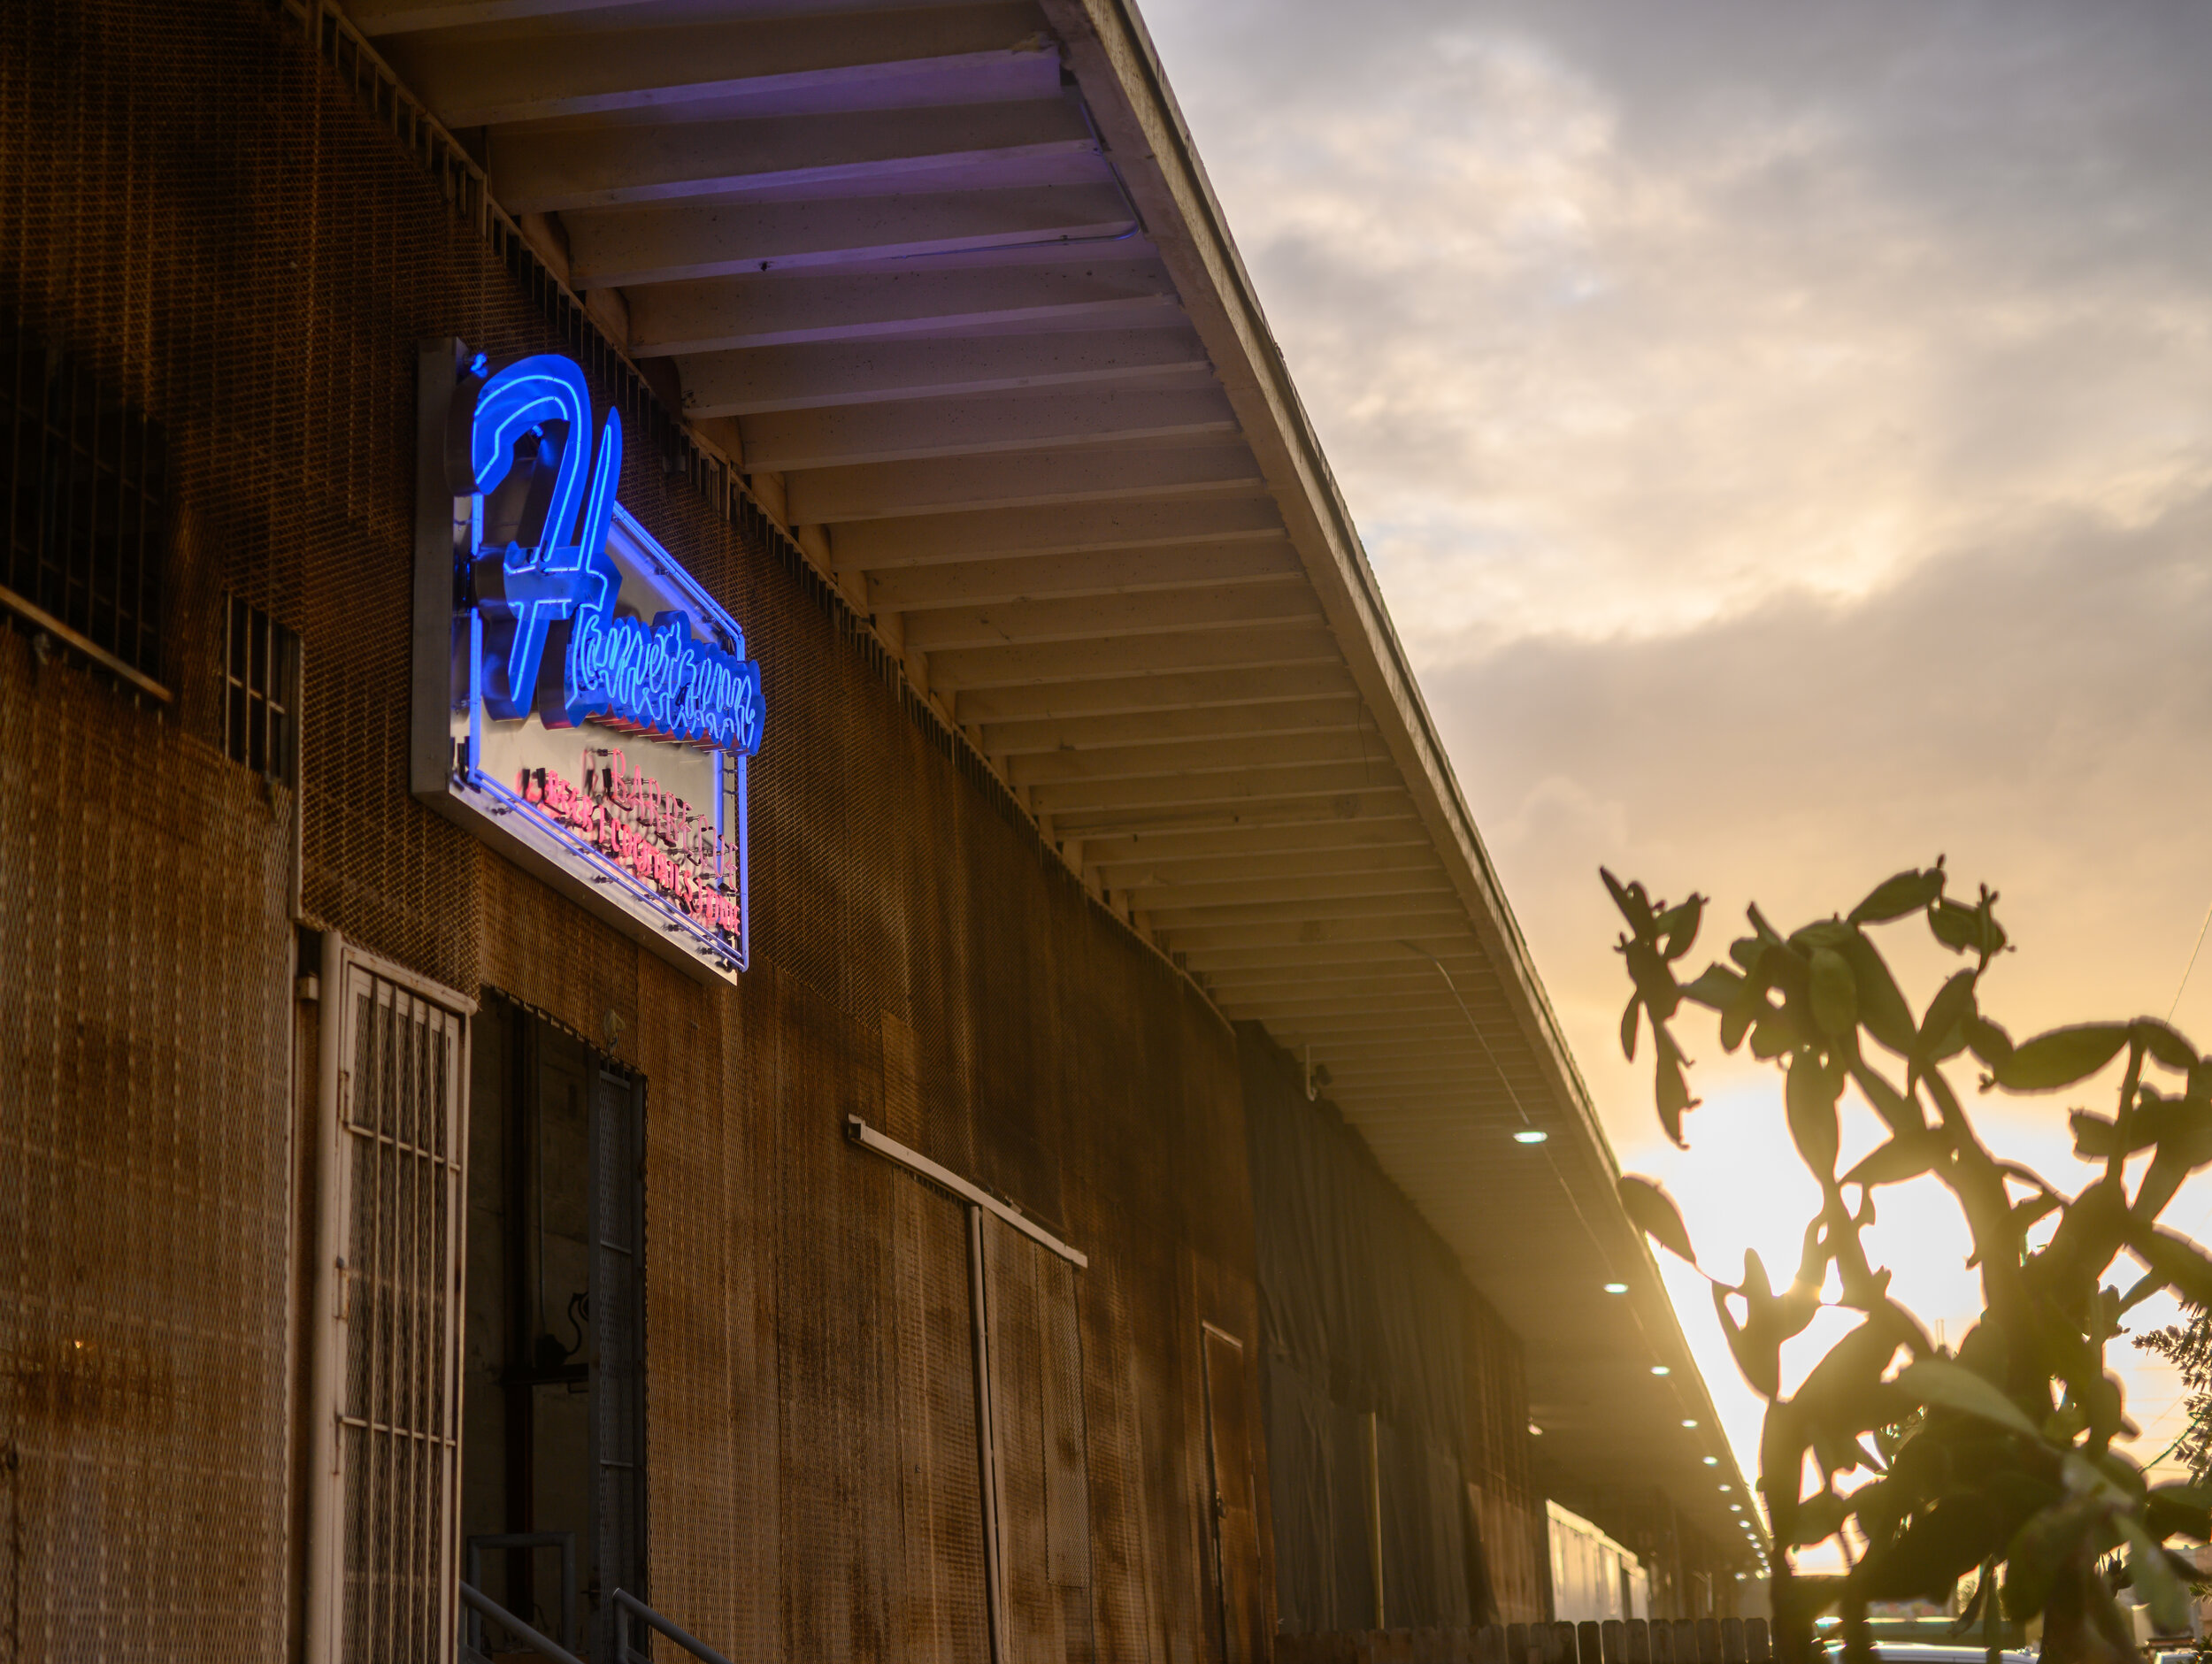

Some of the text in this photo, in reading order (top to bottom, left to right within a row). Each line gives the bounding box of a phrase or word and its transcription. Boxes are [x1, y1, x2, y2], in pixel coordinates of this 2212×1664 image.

[545, 769, 594, 832] BEER
[611, 817, 692, 902] COCKTAILS
[609, 748, 739, 893] BARBECUE
